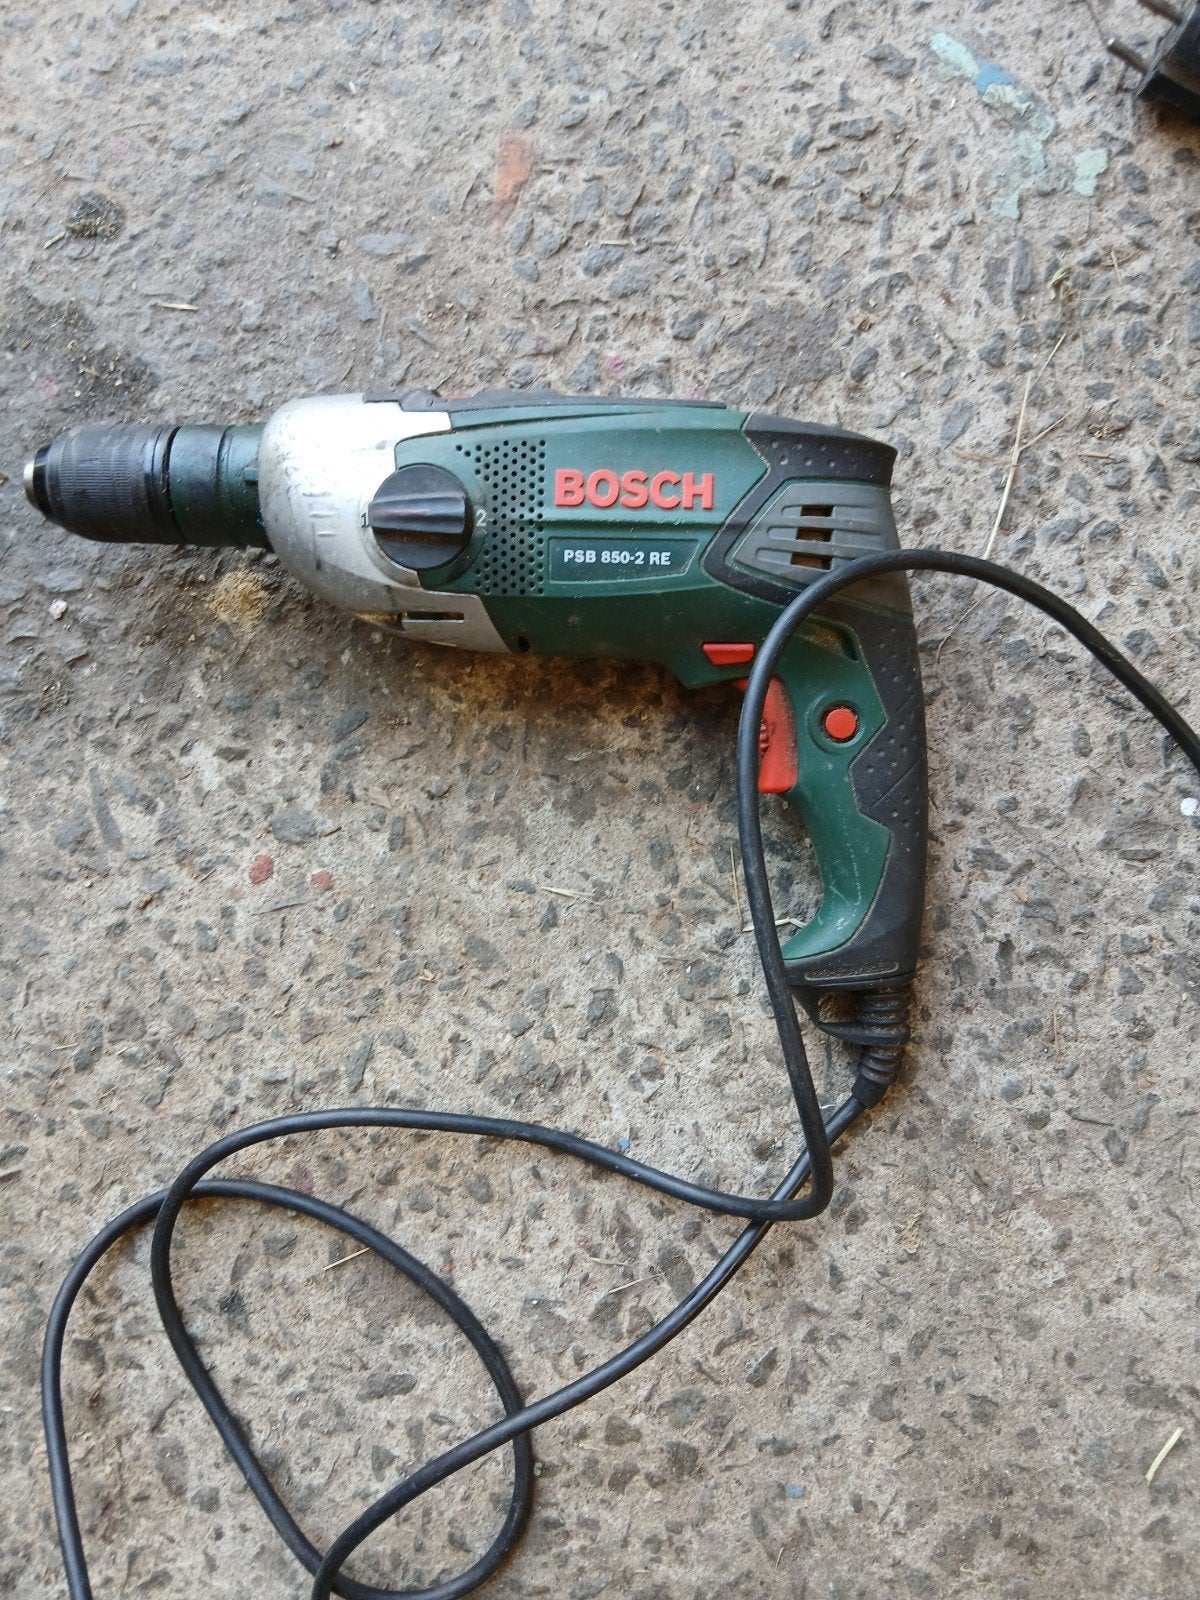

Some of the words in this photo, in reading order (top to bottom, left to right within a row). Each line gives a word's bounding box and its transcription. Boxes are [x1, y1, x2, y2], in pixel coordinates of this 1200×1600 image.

[554, 468, 715, 511] BOSCH
[360, 511, 370, 529] 1
[475, 508, 488, 527] 2
[563, 549, 597, 564] PSB
[600, 550, 646, 565] 850-2
[649, 551, 672, 566] RE
